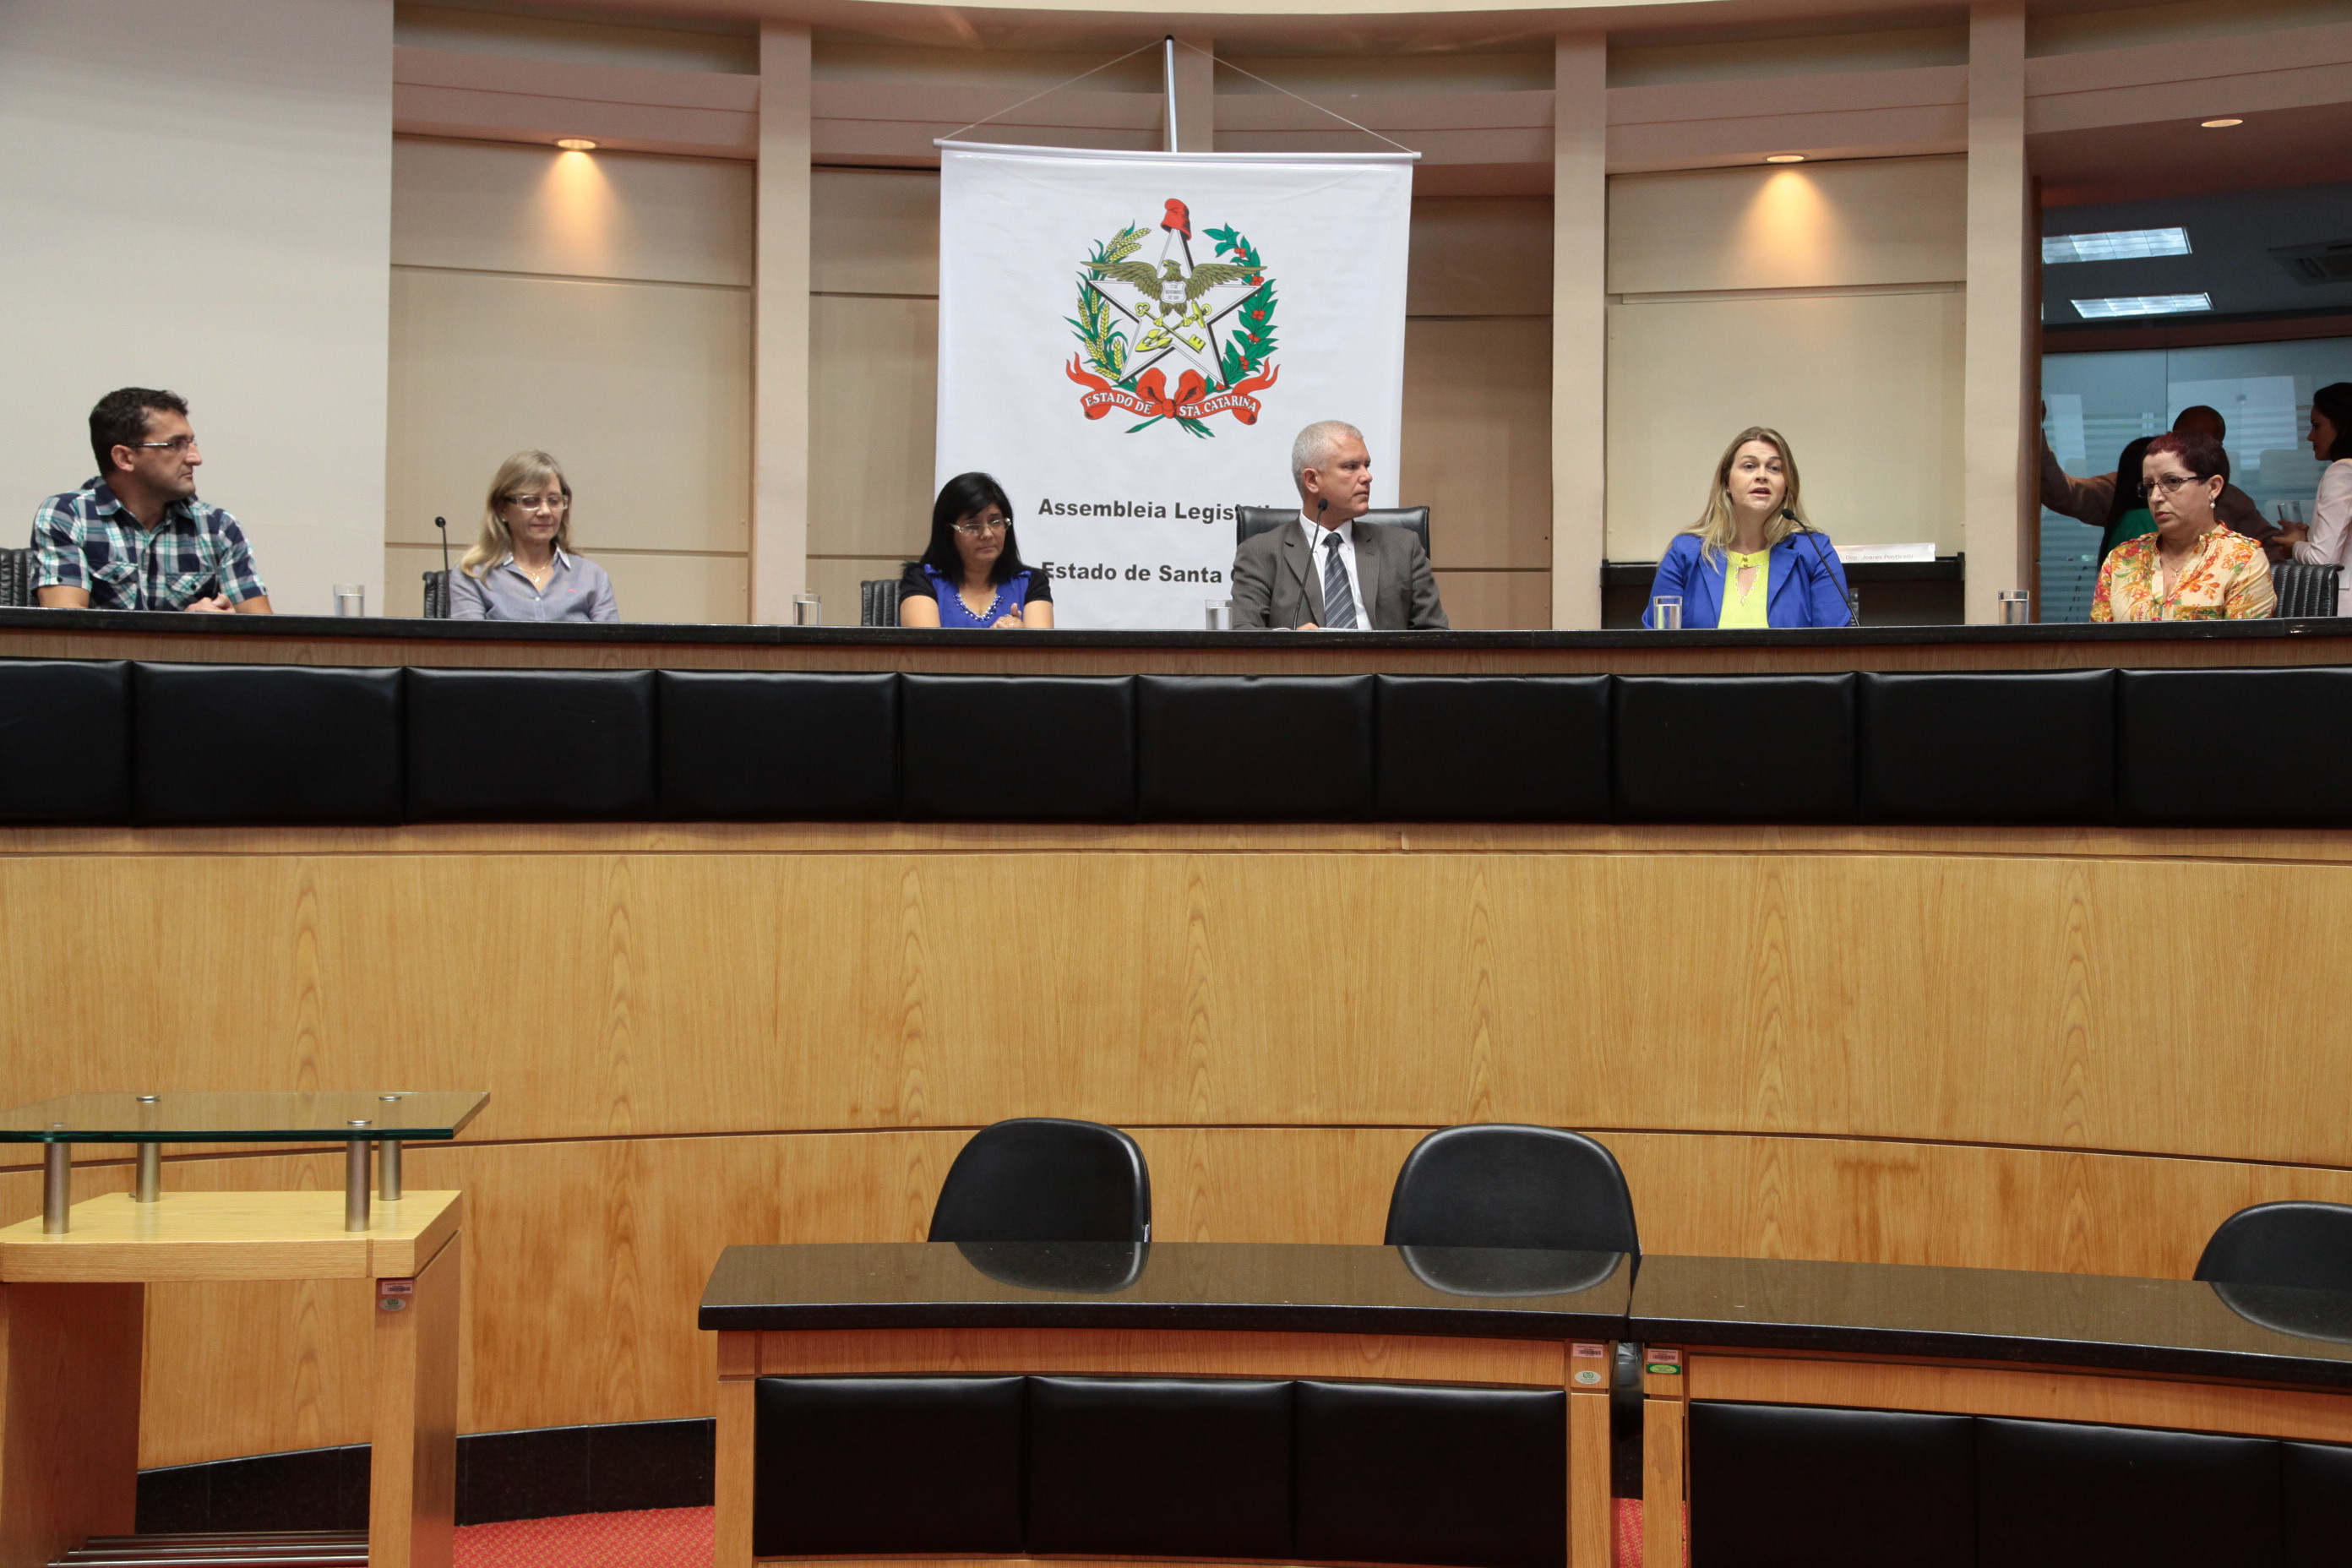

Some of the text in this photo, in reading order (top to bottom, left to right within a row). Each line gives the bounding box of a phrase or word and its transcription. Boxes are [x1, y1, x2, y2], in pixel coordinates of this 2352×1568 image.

[1085, 392, 1256, 416] ESTADO DE STA. CATARINA
[1037, 498, 1240, 525] Assembleia Legis
[1042, 562, 1117, 580] Estado
[1124, 564, 1151, 581] de
[1158, 564, 1222, 584] Santa
